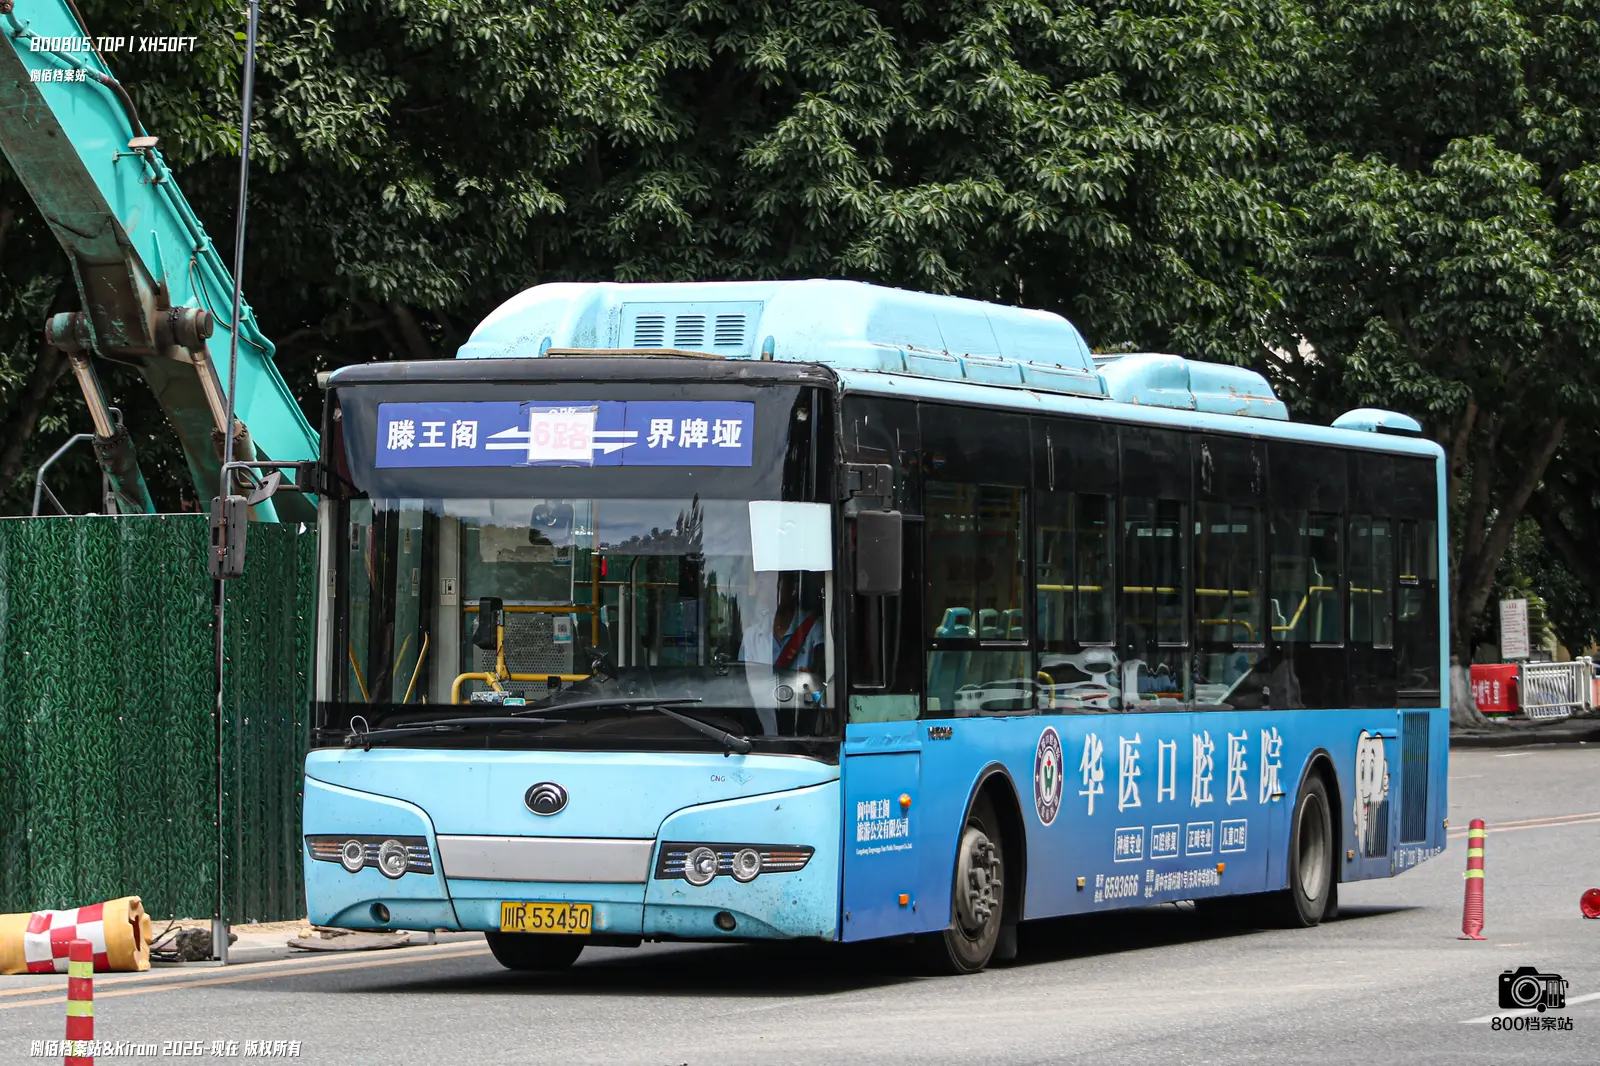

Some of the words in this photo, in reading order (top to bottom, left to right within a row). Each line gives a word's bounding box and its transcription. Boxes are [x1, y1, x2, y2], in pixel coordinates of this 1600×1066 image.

[386, 419, 478, 451] 滕王阁
[533, 420, 591, 450] 6路
[646, 418, 743, 449] 界牌垭
[710, 774, 726, 783] CNG
[1078, 726, 1283, 816] 华医口腔医院
[1104, 873, 1140, 899] 6593666
